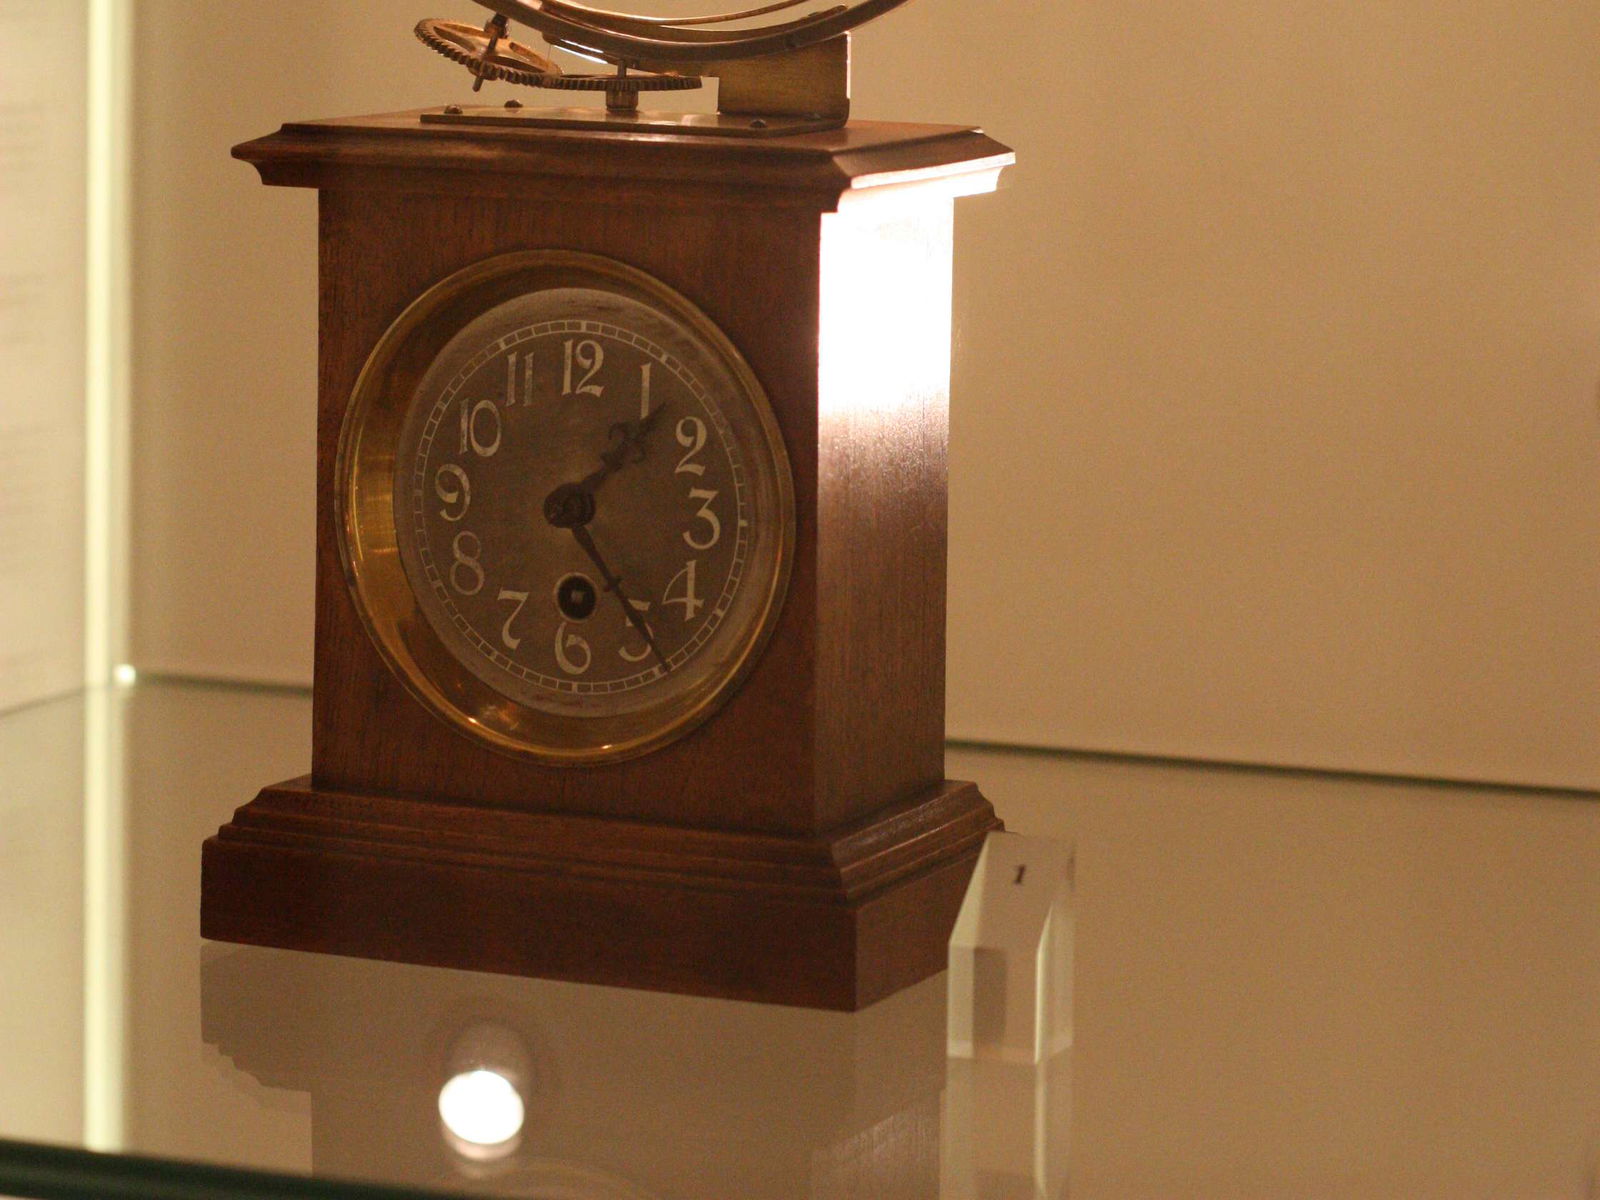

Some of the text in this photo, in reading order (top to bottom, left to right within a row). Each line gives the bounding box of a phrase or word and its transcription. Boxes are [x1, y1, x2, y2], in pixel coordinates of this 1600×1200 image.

[506, 351, 534, 407] 11
[562, 338, 605, 398] 12
[639, 362, 652, 420] 1
[459, 398, 501, 457] 10
[674, 416, 708, 476] 2
[434, 463, 471, 522] 9
[681, 487, 720, 550] 3
[449, 530, 485, 596] 8
[662, 559, 705, 622] 4
[497, 589, 529, 650] 7
[554, 621, 592, 675] 6
[618, 600, 654, 663] 5
